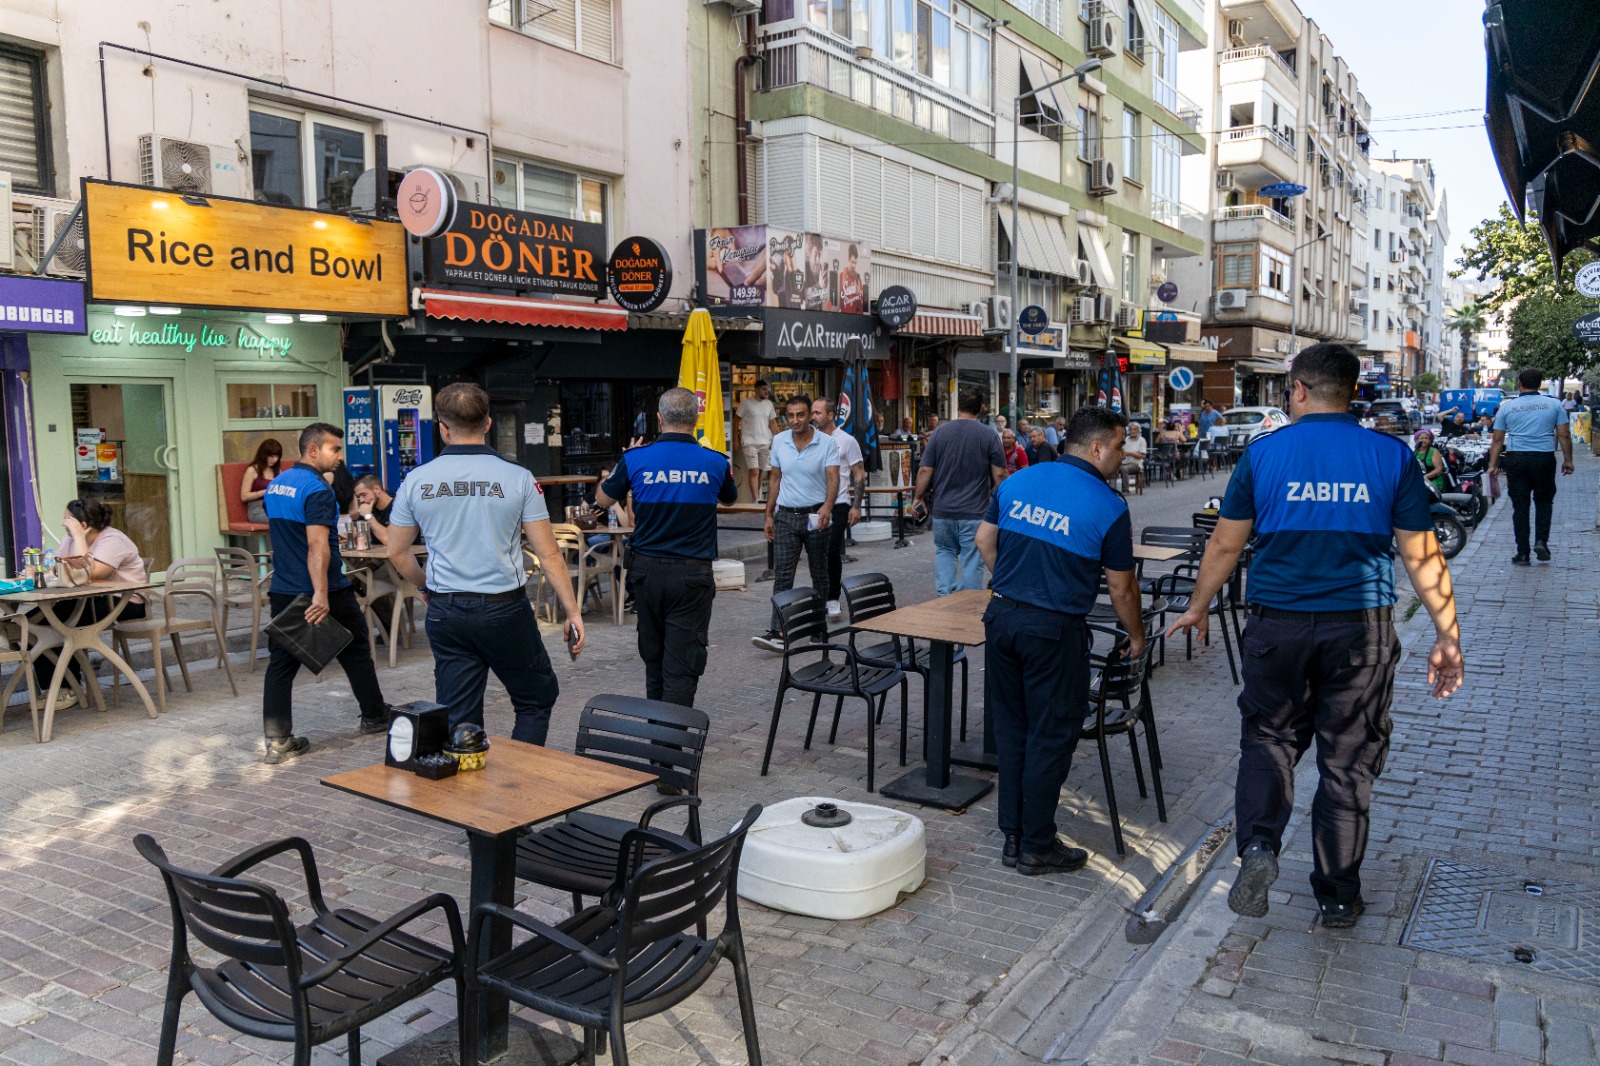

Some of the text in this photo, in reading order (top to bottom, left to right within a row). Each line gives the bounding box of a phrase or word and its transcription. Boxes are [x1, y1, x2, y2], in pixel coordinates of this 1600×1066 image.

[470, 210, 574, 243] DOĞADAN
[127, 228, 382, 281] Rice and Bowl
[444, 232, 598, 282] DÖNER
[615, 257, 659, 268] DOĞADAN
[445, 268, 473, 279] YAPRAK
[474, 271, 483, 280] ET
[484, 271, 507, 283] DÖNER
[508, 275, 513, 283] &
[559, 280, 578, 289] TAVUK
[578, 281, 598, 291] DÖNER
[621, 270, 652, 281] DÖNER
[881, 294, 910, 307] AÇAR
[881, 307, 911, 315] TEKNOLOJİ
[92, 321, 125, 344] eat
[129, 322, 197, 352] healthy
[238, 327, 291, 358] happy
[777, 321, 875, 352] AÇAR TEKNOJİ
[348, 423, 373, 437] PEPS
[643, 470, 710, 485] ZABITA
[267, 484, 297, 499] ZABITA
[420, 481, 505, 500] ZABITA
[1286, 482, 1370, 503] ZABITA
[1009, 500, 1070, 536] ZABITA
